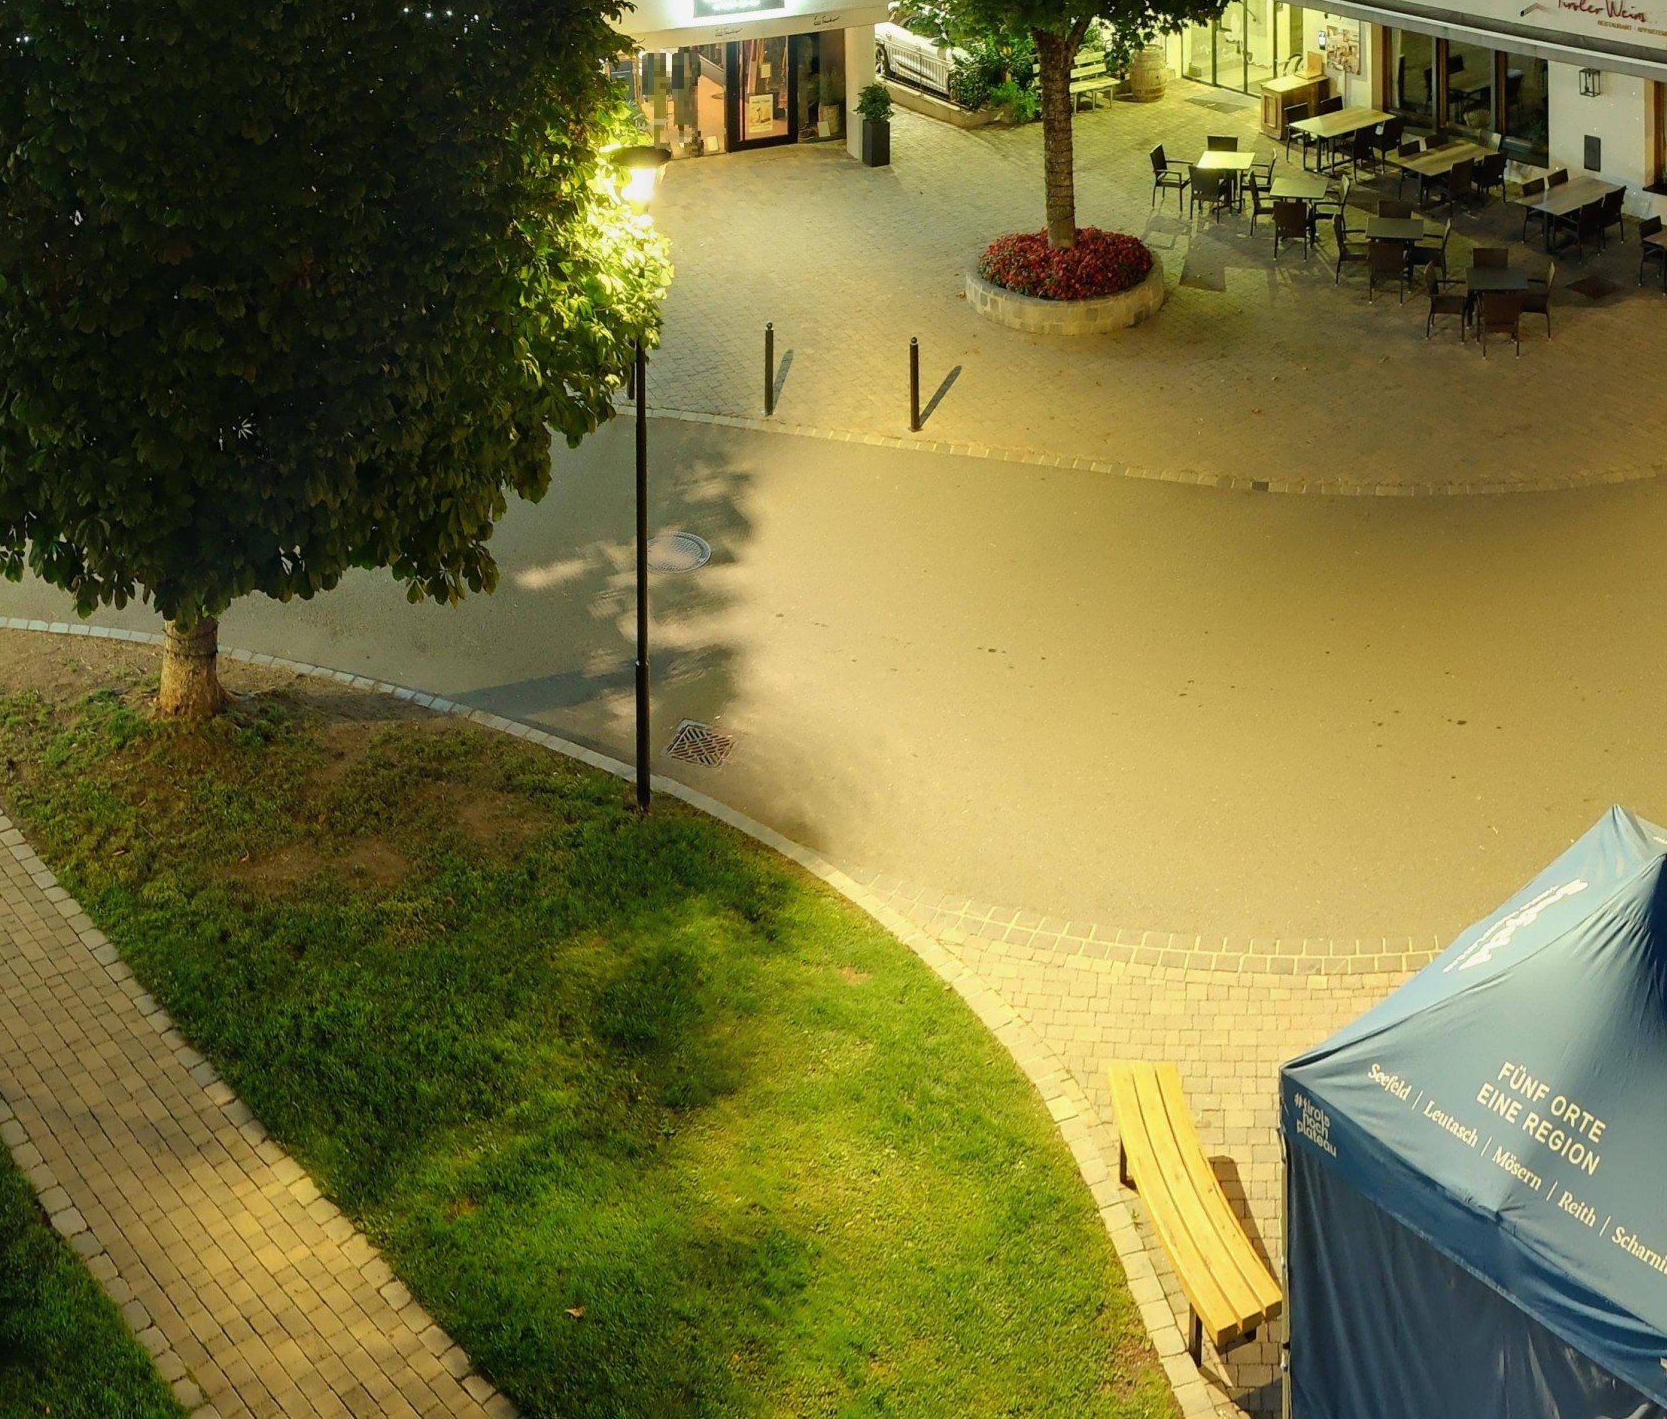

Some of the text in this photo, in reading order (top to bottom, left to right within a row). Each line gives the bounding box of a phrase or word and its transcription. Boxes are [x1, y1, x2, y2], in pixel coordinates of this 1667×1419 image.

[1597, 19, 1632, 32] RESTAURANT
[1294, 1092, 1331, 1128] #tirols
[1497, 1061, 1606, 1143] FÜNF ORTE
[1296, 1121, 1337, 1158] plateau
[1302, 1109, 1329, 1140] hoch
[1476, 1081, 1601, 1175] EINE REGION
[1368, 1063, 1412, 1101] Seefeld
[1423, 1100, 1479, 1148] Leutasch
[1492, 1146, 1542, 1191] Mösern
[1557, 1190, 1597, 1228] Reith
